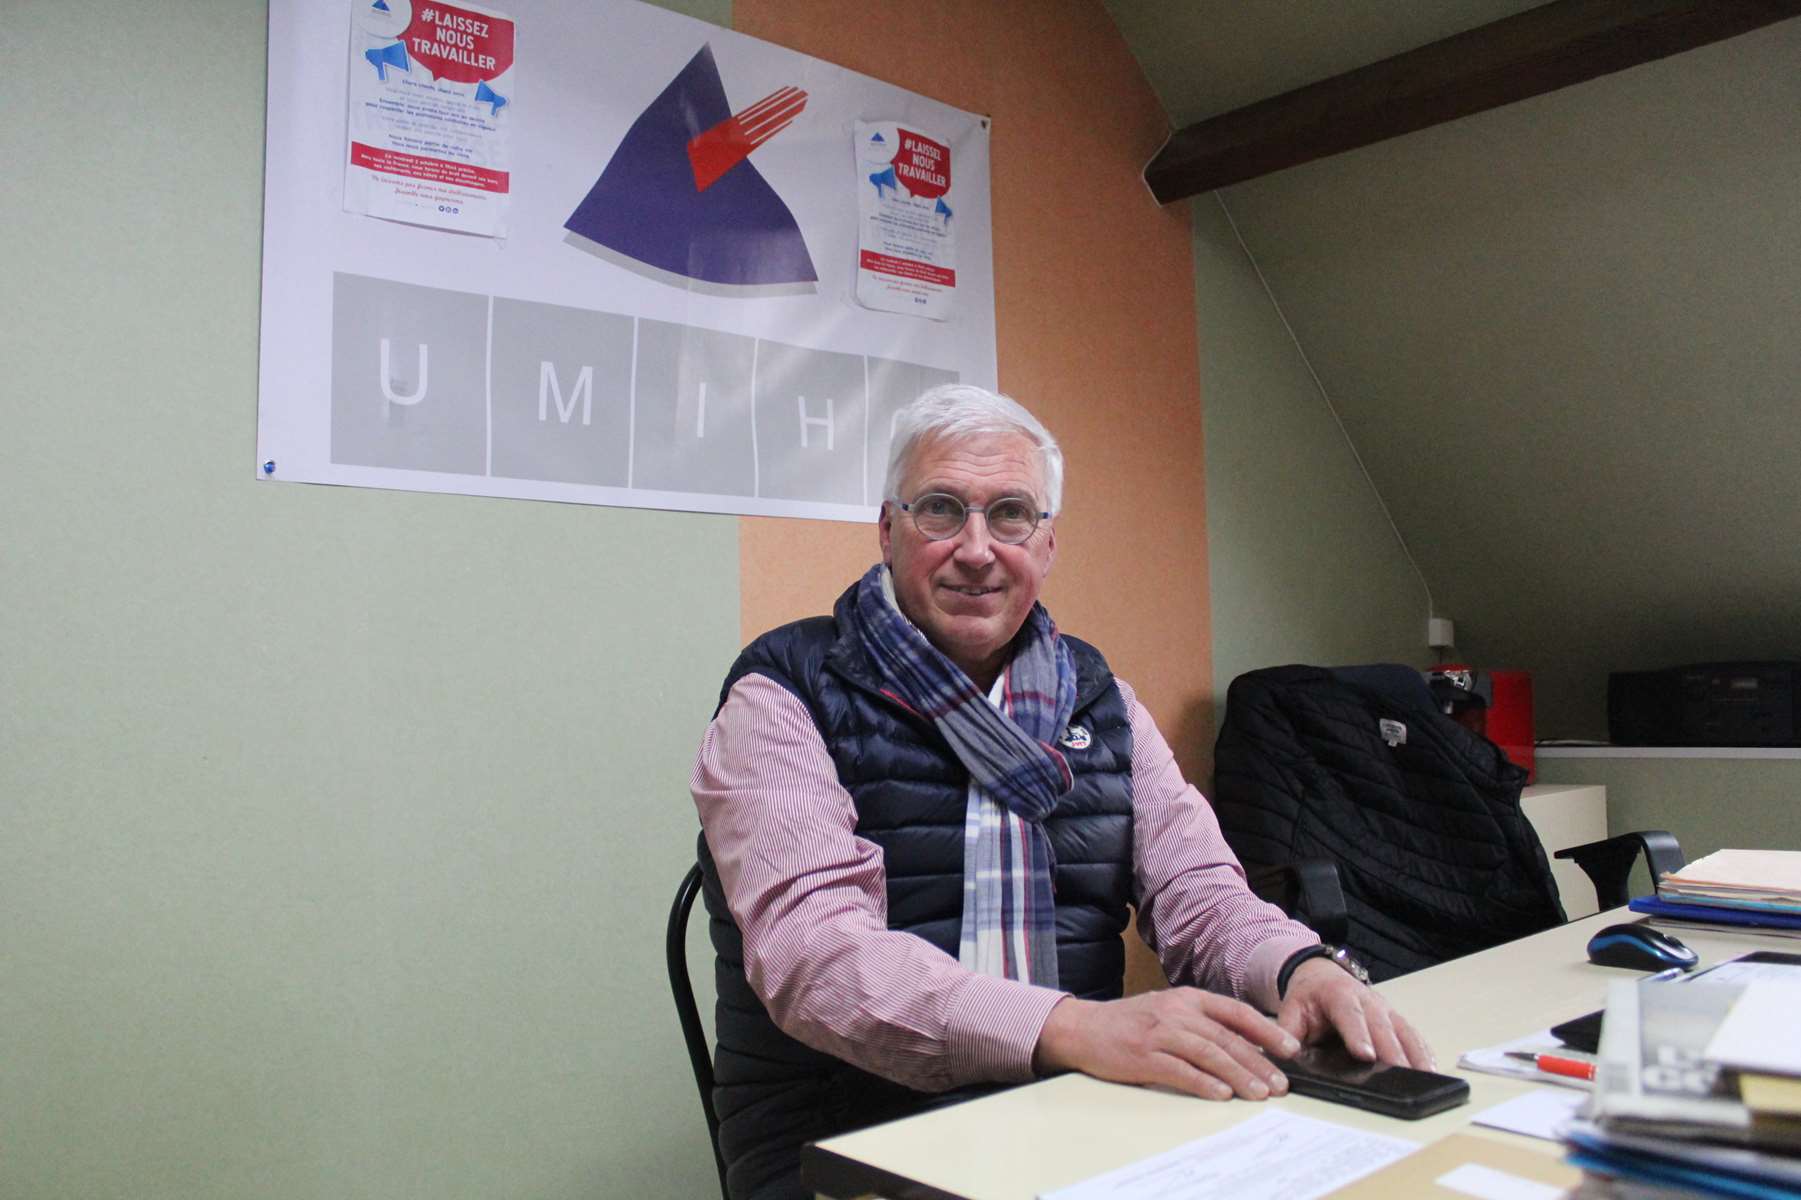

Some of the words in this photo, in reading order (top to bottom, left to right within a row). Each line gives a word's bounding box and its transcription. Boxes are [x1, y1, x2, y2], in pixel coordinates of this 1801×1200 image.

[421, 8, 489, 38] #LAISSEZ
[436, 28, 474, 50] NOUS
[412, 38, 496, 71] TRAVAILLER
[904, 138, 941, 160] #LAISSEZ
[912, 154, 935, 171] NOUS
[898, 163, 946, 187] TRAVAILLER
